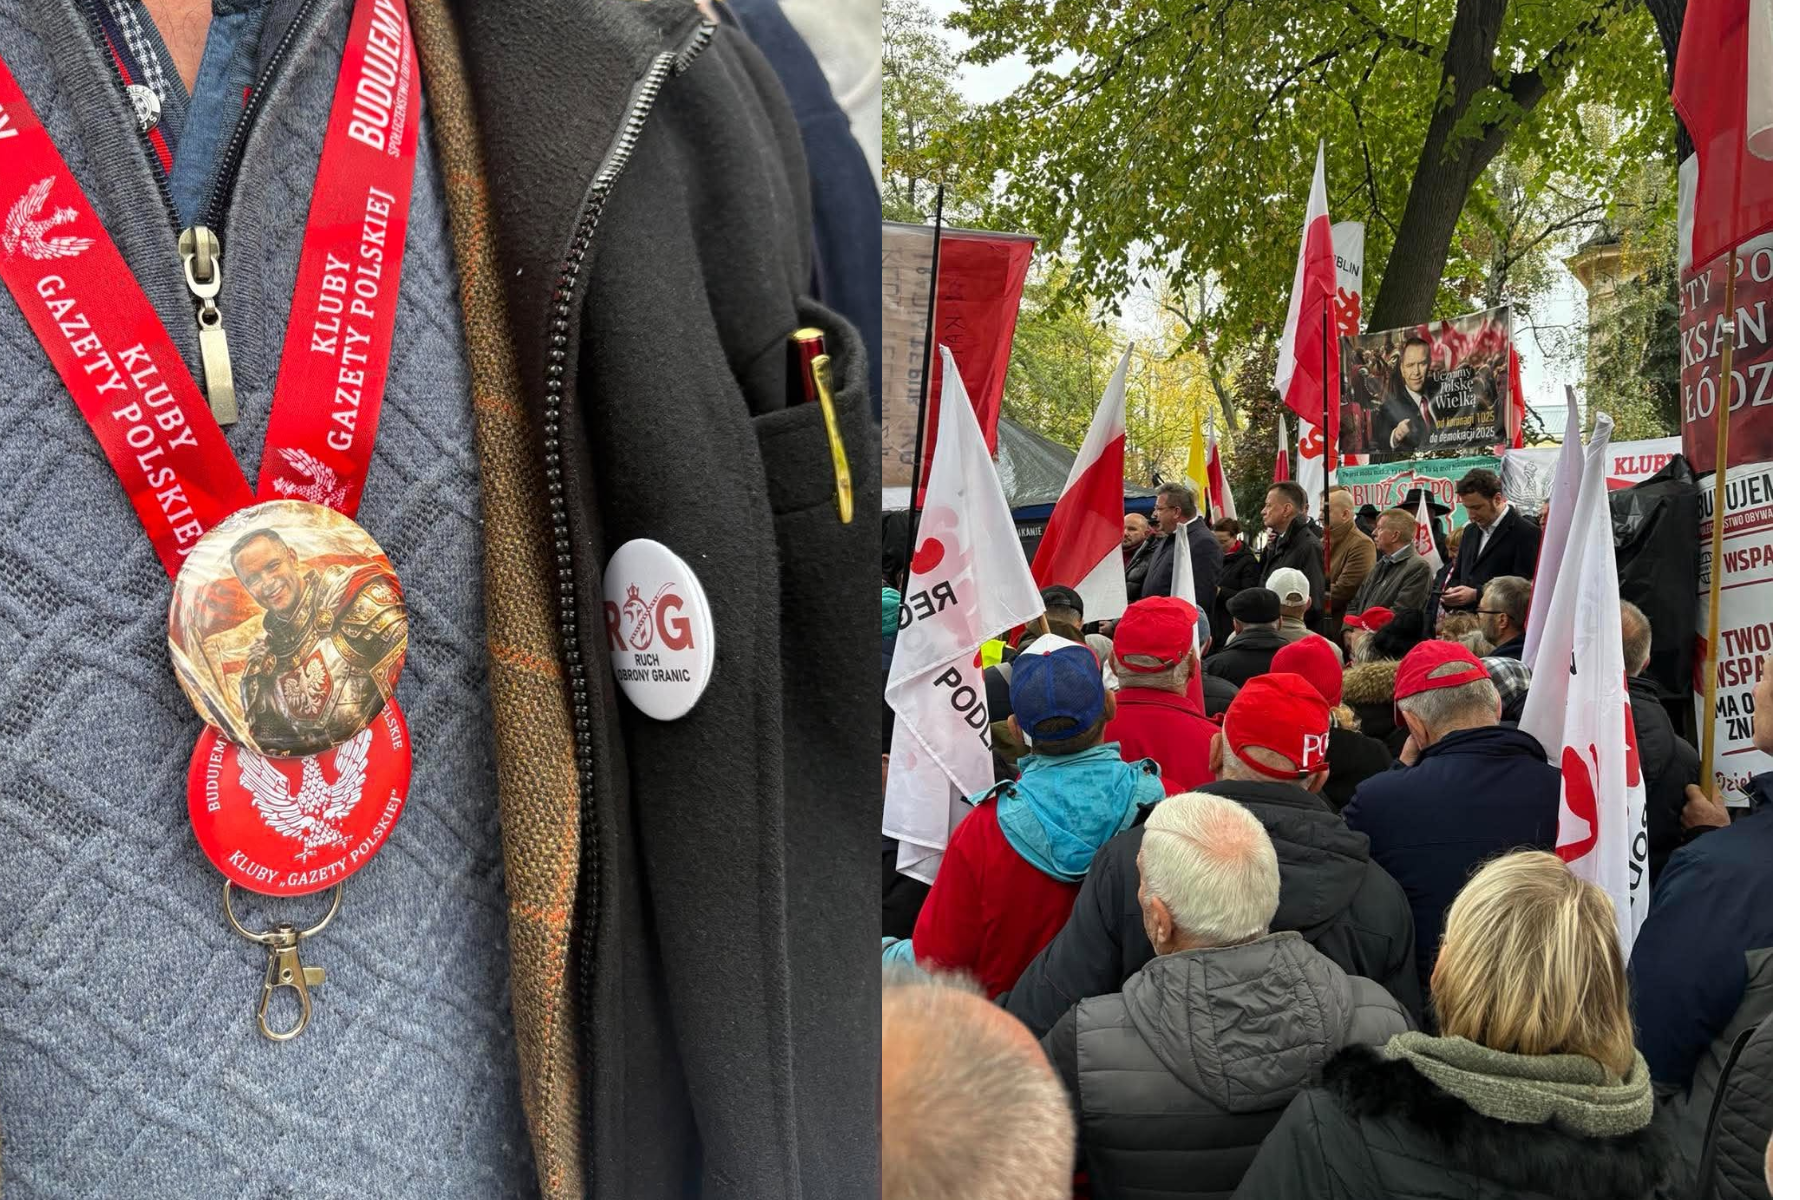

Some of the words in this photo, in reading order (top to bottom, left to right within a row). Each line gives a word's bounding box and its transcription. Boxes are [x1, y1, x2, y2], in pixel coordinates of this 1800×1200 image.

[348, 0, 402, 151] BUDUJEMY
[1334, 254, 1360, 277] BLIN
[311, 254, 350, 356] KLUBY
[327, 328, 373, 451] GAZETY
[351, 186, 396, 319] POLSKIEJ
[36, 275, 128, 397] GAZETY
[118, 342, 197, 451] KLUBY
[1435, 391, 1477, 410] Wielką
[1477, 411, 1495, 424] 1025
[1429, 432, 1438, 444] do
[1475, 426, 1495, 438] 2025
[1614, 453, 1675, 475] KLUB
[1721, 621, 1773, 658] TWO
[617, 668, 650, 683] OBRONY
[651, 668, 691, 683] GRANIC
[634, 653, 660, 667] RUCH
[933, 666, 994, 752] PODL
[1726, 716, 1756, 741] ZN
[228, 849, 280, 886] KLUBY
